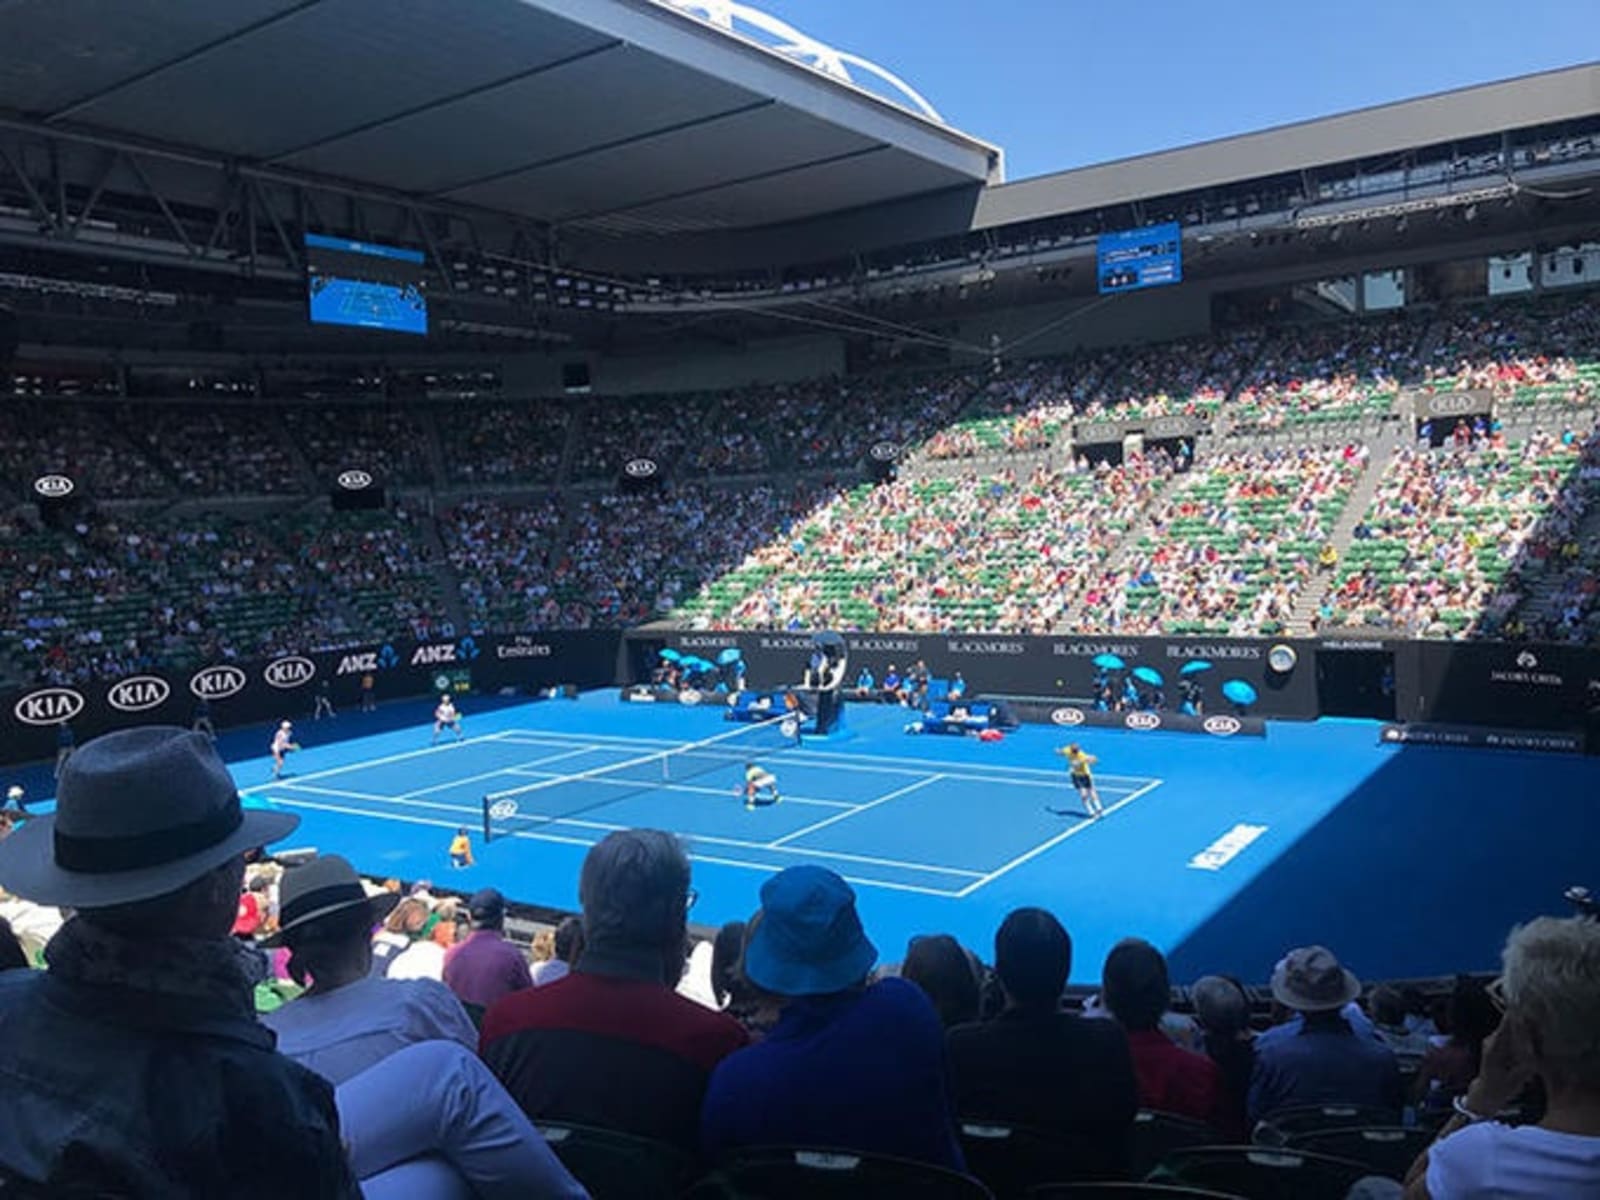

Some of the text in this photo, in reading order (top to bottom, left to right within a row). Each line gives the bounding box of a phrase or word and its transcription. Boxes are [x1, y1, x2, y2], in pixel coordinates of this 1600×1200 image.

[411, 644, 456, 665] ANZ
[948, 640, 1025, 654] BLACKMORES
[1053, 642, 1138, 657] BLACKMORES
[1166, 645, 1261, 659] BLACKMORES
[273, 663, 307, 681] KIA
[336, 653, 378, 675] ANZ
[201, 672, 237, 693] KIA
[119, 683, 160, 704] KIA
[27, 695, 73, 718] KIA
